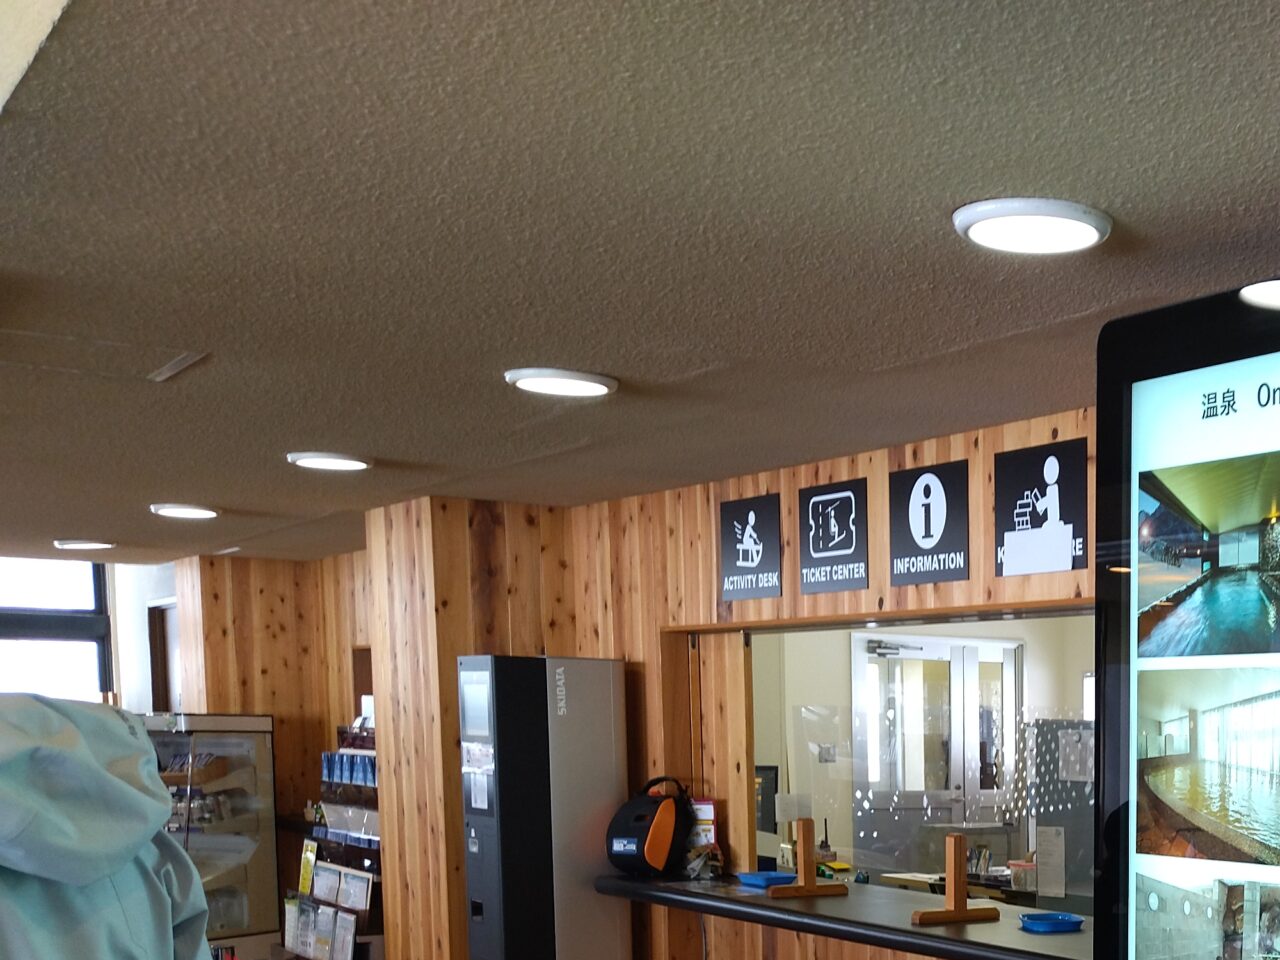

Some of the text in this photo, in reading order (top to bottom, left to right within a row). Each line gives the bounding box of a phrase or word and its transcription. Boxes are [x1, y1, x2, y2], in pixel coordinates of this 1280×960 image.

[1201, 387, 1237, 419] 温泉
[802, 562, 865, 583] TICKET CENTER
[893, 551, 964, 574] INFORMATION
[724, 572, 779, 591] ACTIVITY DESK
[556, 667, 566, 715] SKIDATA
